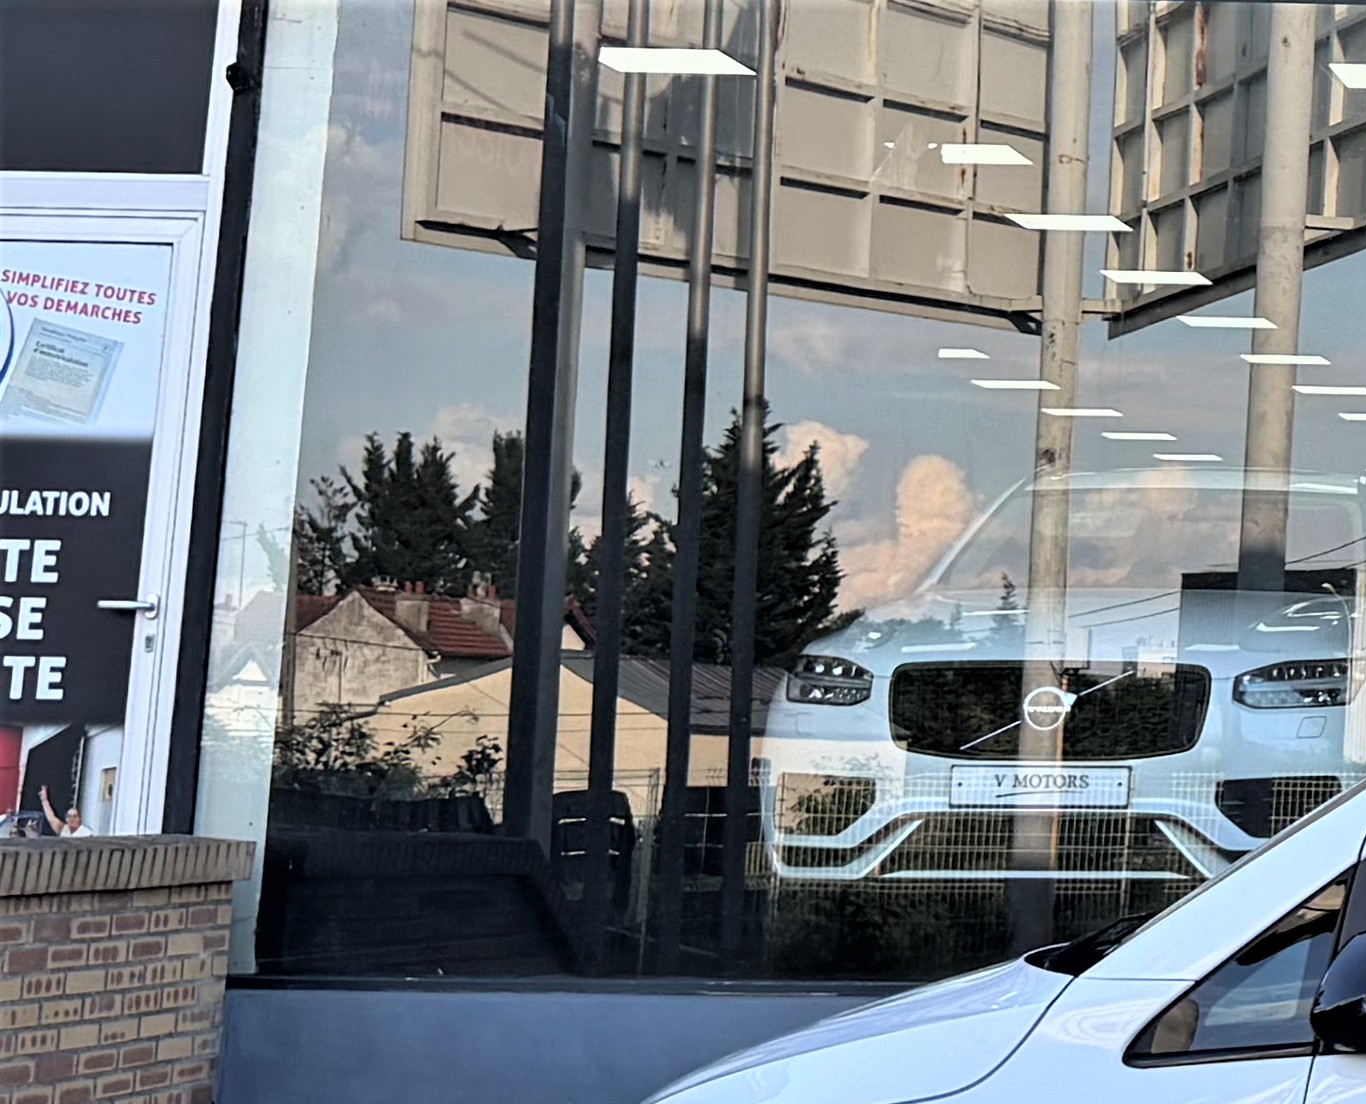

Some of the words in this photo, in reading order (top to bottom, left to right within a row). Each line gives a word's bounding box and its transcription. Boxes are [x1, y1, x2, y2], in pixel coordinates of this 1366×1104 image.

[1, 269, 90, 295] SIMPLIFIEZ
[94, 283, 157, 305] TOUTES
[7, 290, 39, 308] VOS
[43, 297, 142, 324] DEMARCHES
[0, 538, 62, 583] TE
[3, 655, 67, 700] TE
[994, 773, 1008, 788] V
[1012, 773, 1090, 789] MOTORS
